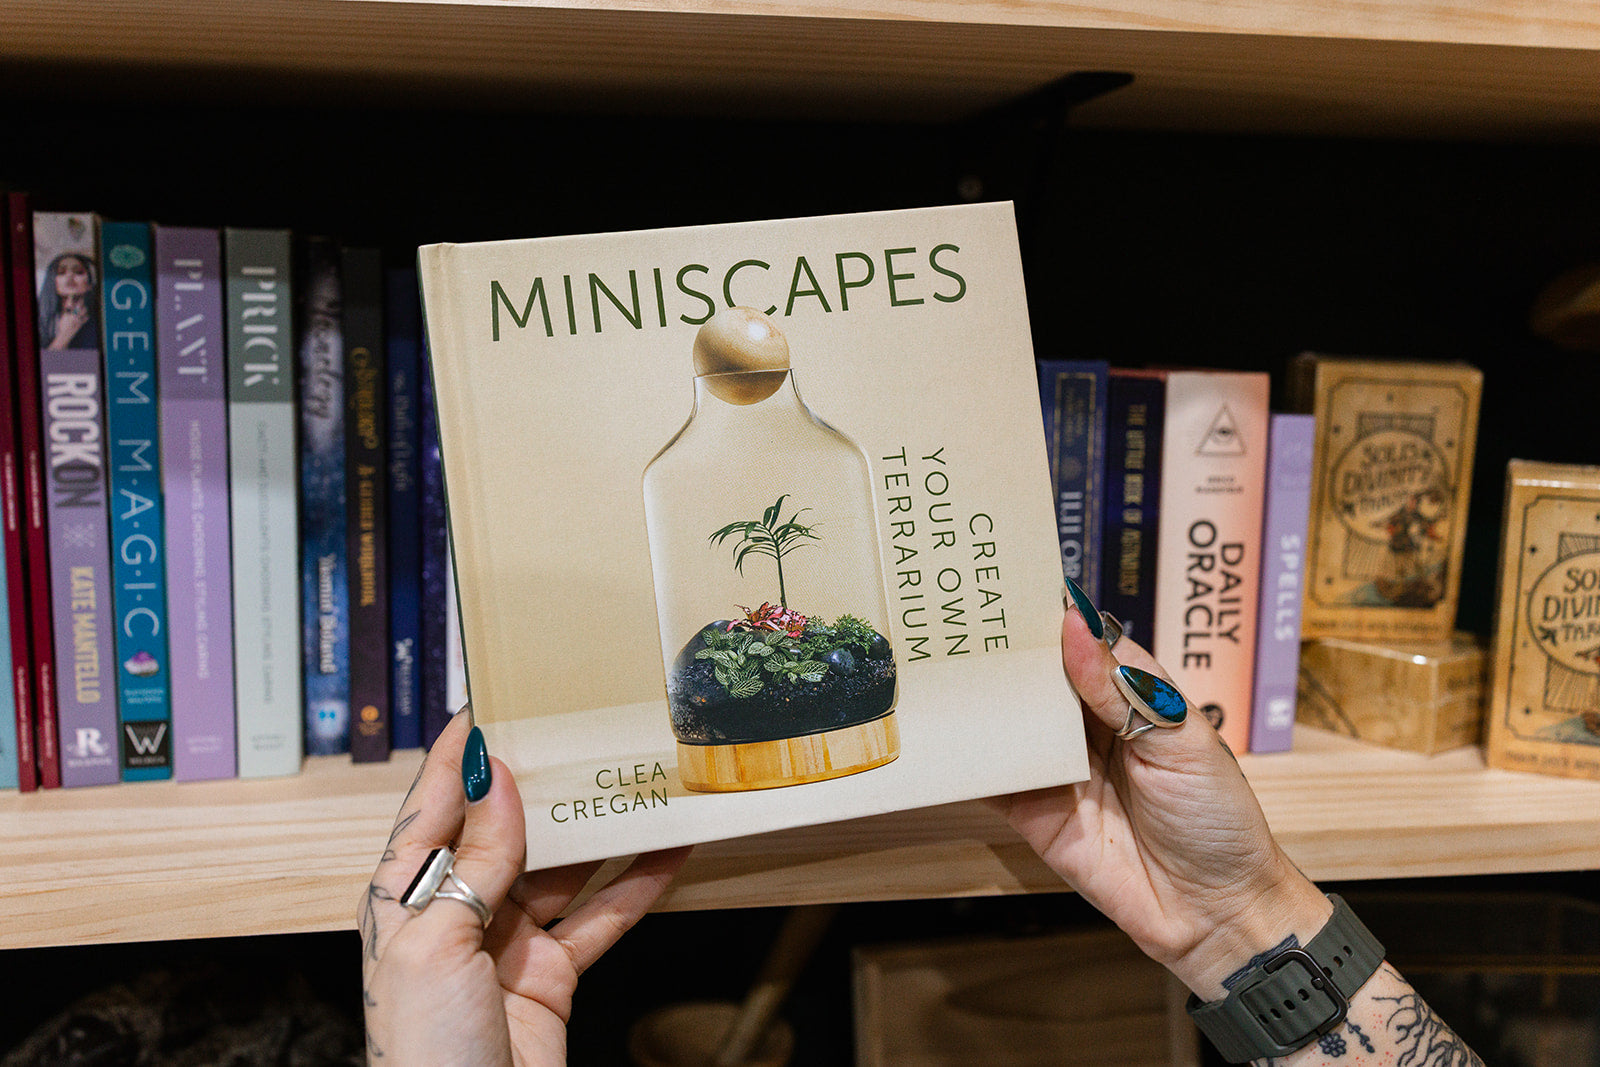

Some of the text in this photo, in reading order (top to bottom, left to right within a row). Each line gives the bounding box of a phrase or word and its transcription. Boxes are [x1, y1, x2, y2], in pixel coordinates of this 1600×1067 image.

[241, 266, 280, 387] PRICK
[490, 243, 967, 342] MINISCAPES
[882, 446, 931, 662] TERRARIUM
[921, 447, 971, 656] YOUR OWN
[969, 513, 1009, 653] CREATE
[1182, 519, 1217, 669] ORACLE
[1216, 542, 1244, 645] DAILY
[1274, 534, 1300, 641] SPELLS
[551, 787, 669, 823] CREGAN
[595, 761, 668, 790] CLEA
